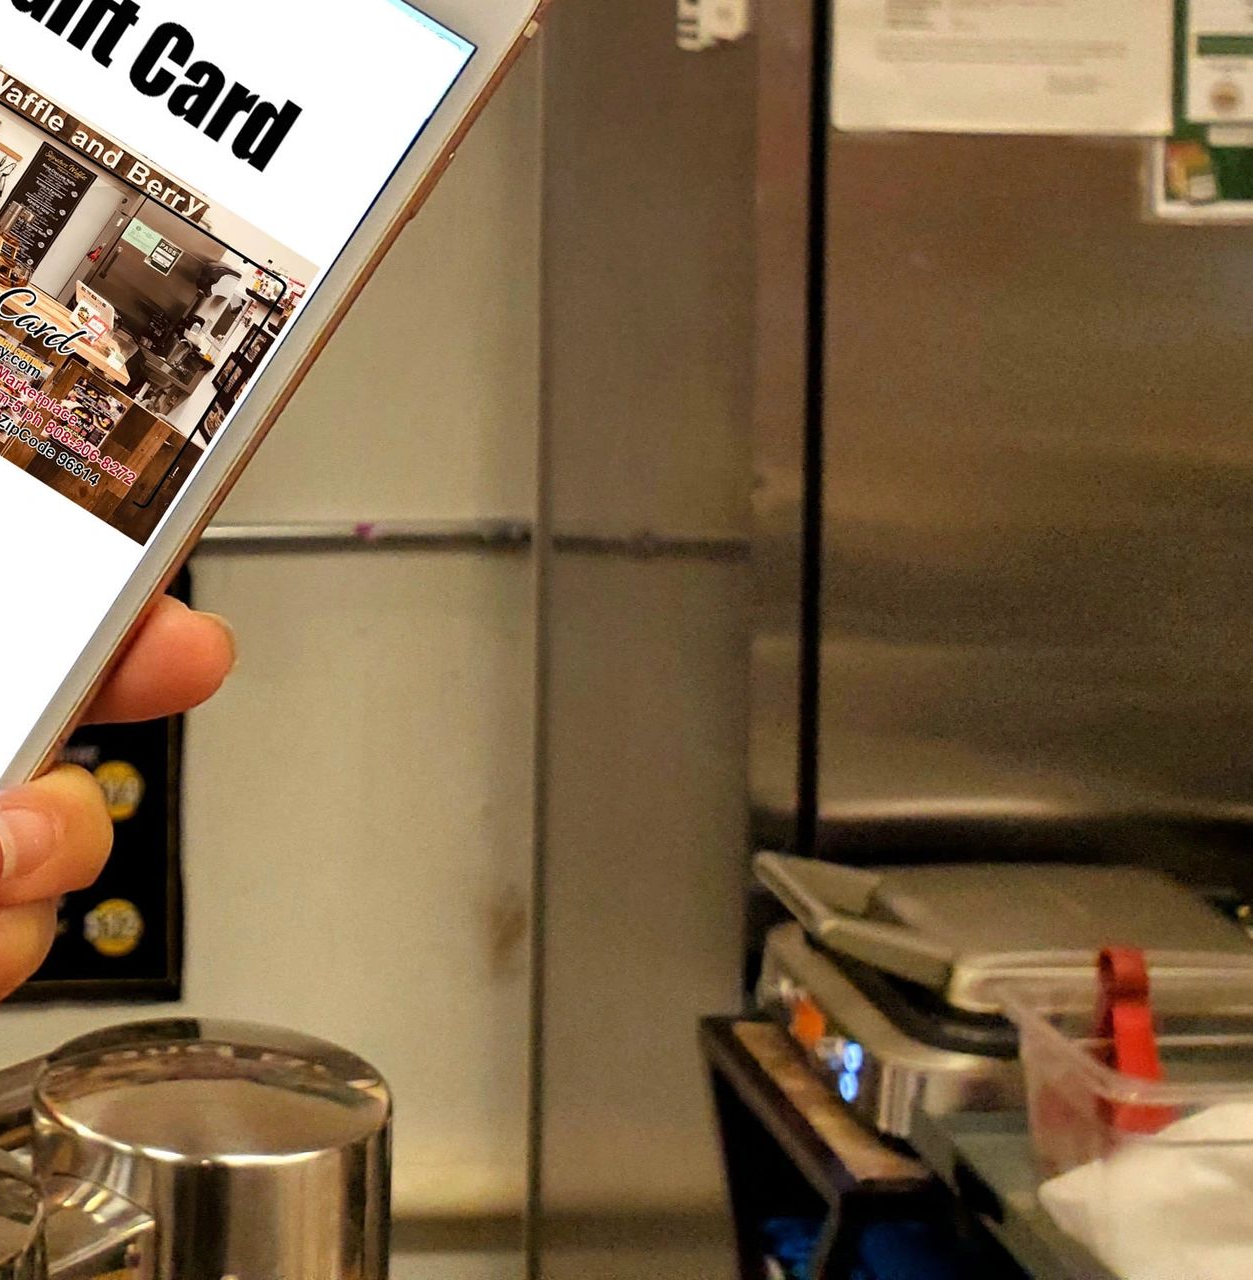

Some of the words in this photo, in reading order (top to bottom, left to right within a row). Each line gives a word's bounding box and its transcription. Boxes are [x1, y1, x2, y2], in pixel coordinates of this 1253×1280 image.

[129, 21, 303, 172] Card
[70, 129, 124, 170] and
[159, 242, 178, 257] PASS
[23, 409, 43, 429] ph
[44, 421, 138, 486] 808-206-8272
[56, 451, 101, 487] 96814
